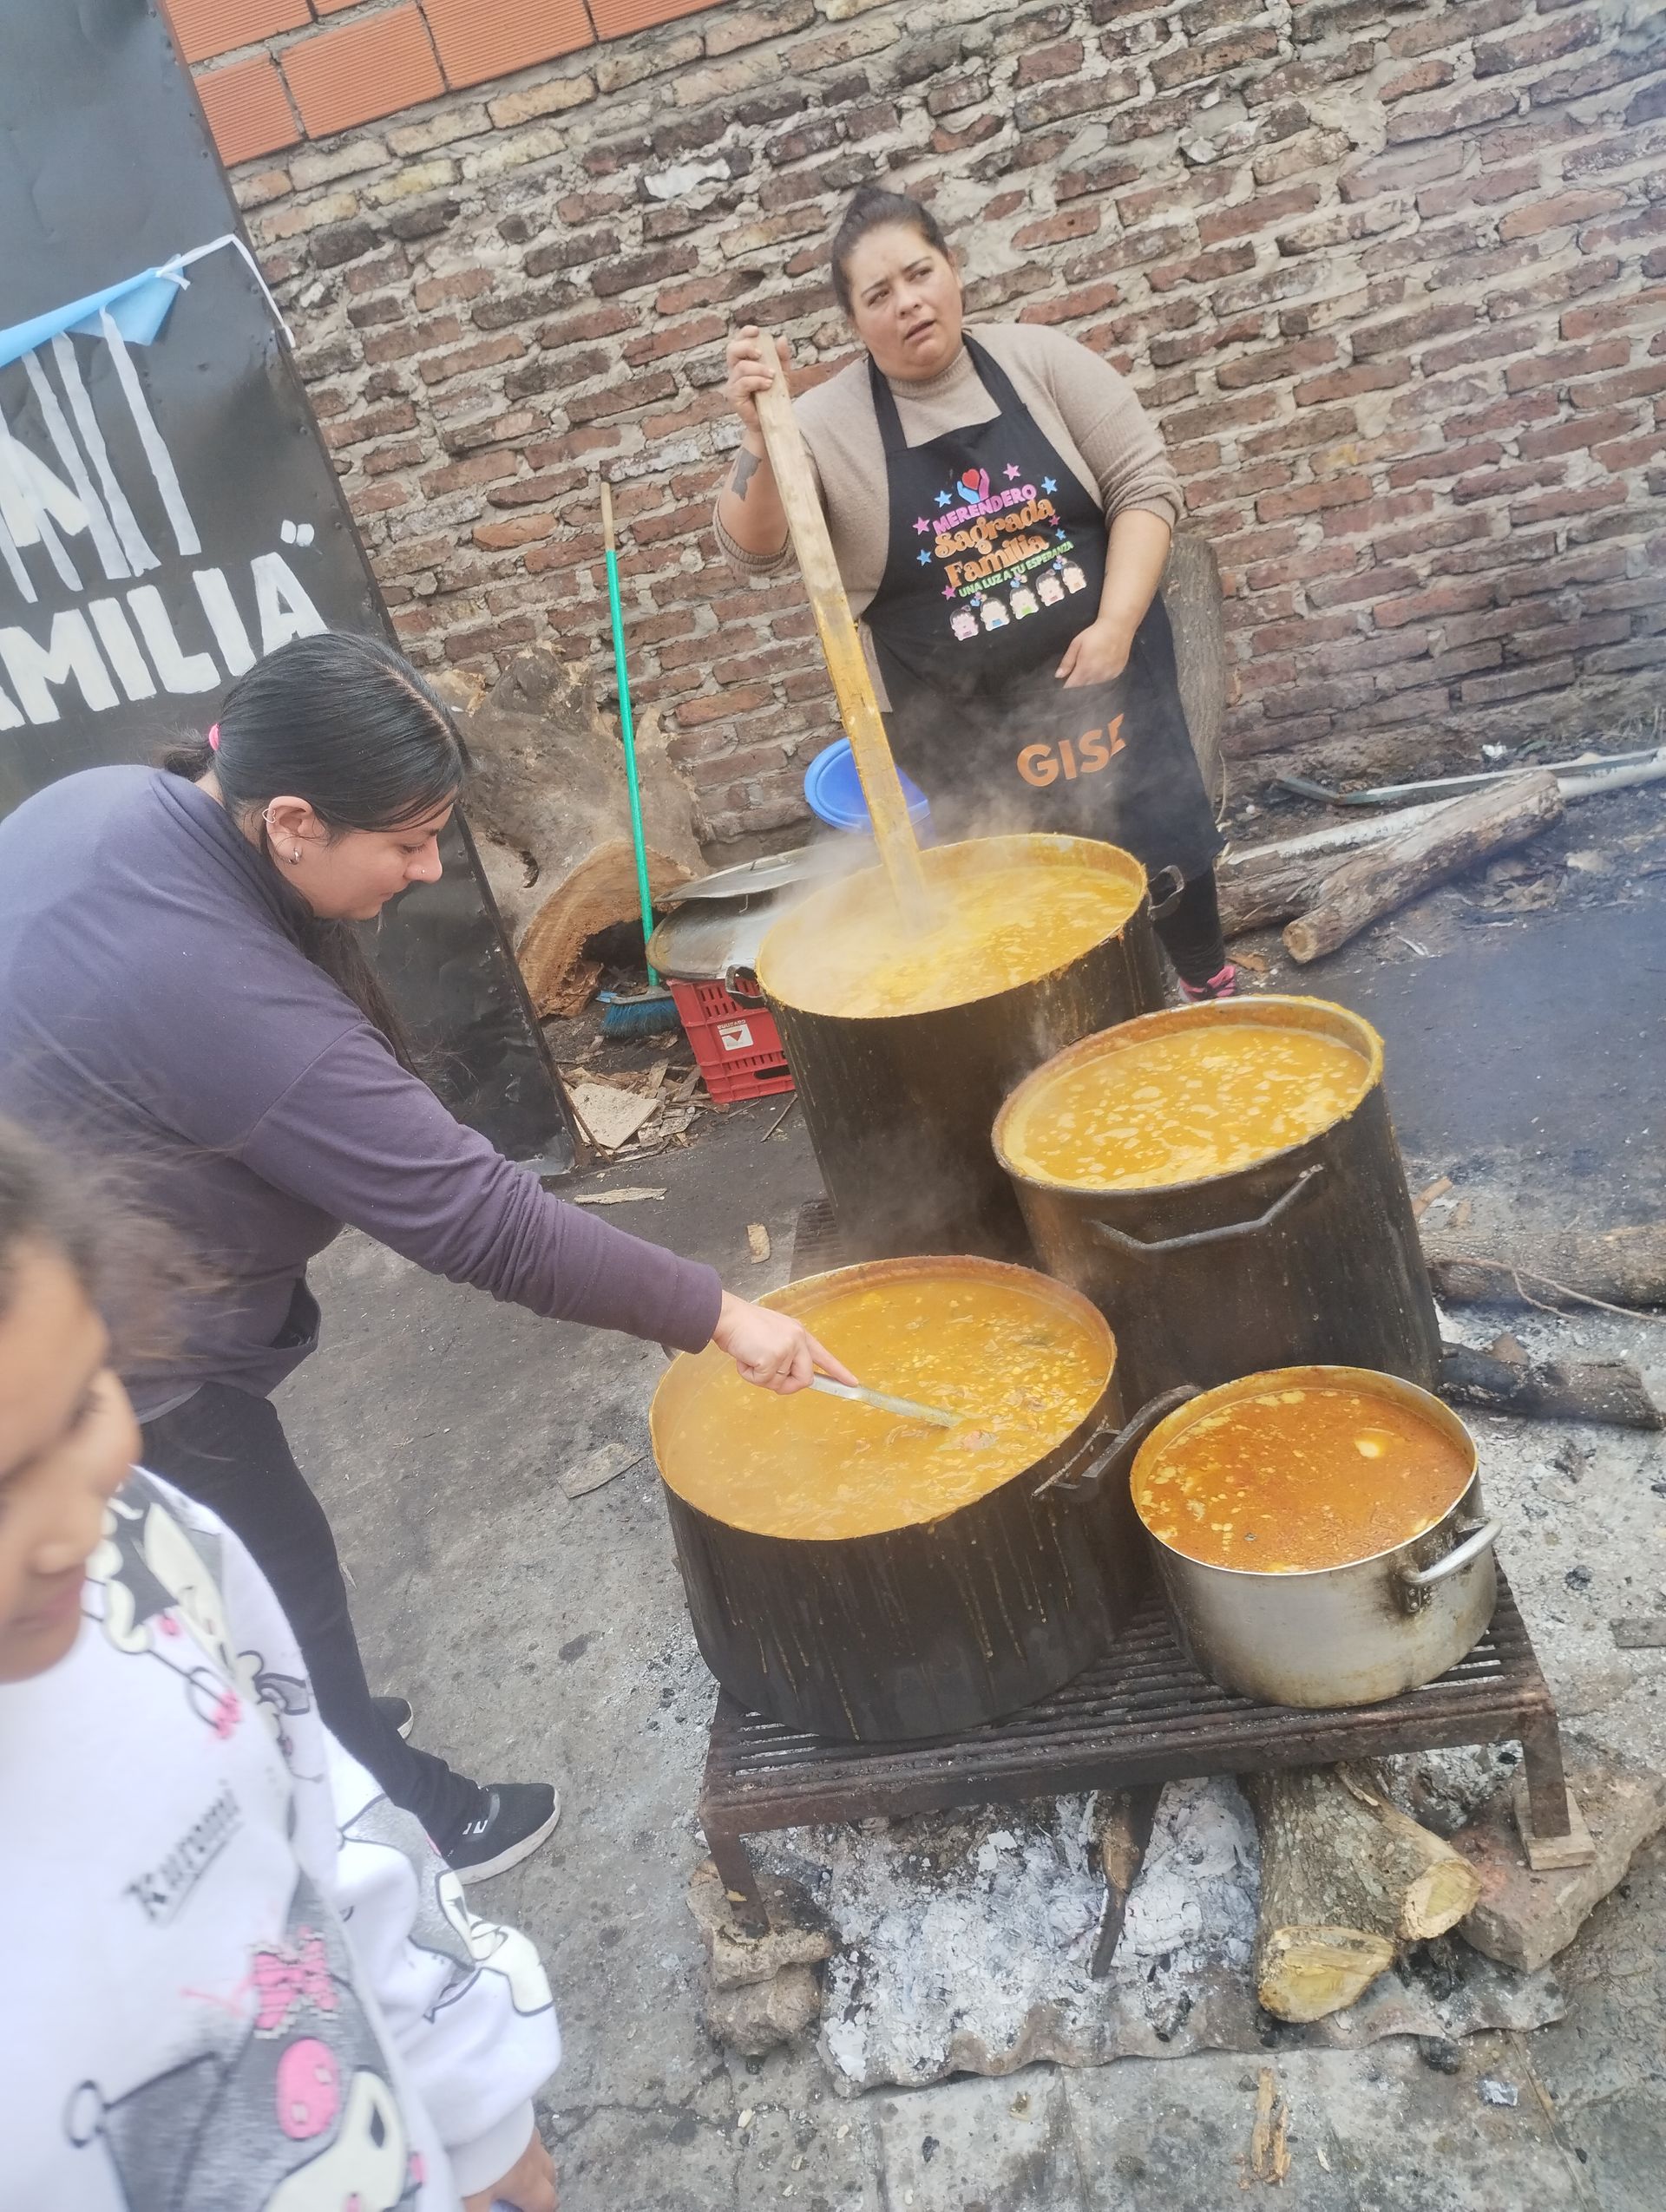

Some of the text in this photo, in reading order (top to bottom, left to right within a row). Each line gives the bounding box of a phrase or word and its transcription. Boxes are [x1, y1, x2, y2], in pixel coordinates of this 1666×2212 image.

[932, 484, 1038, 535] MERENDERO
[935, 498, 1055, 559] Sagrada
[944, 534, 1050, 588] Familia
[958, 540, 1075, 598] UNA LUZ A TU ESPERANZA
